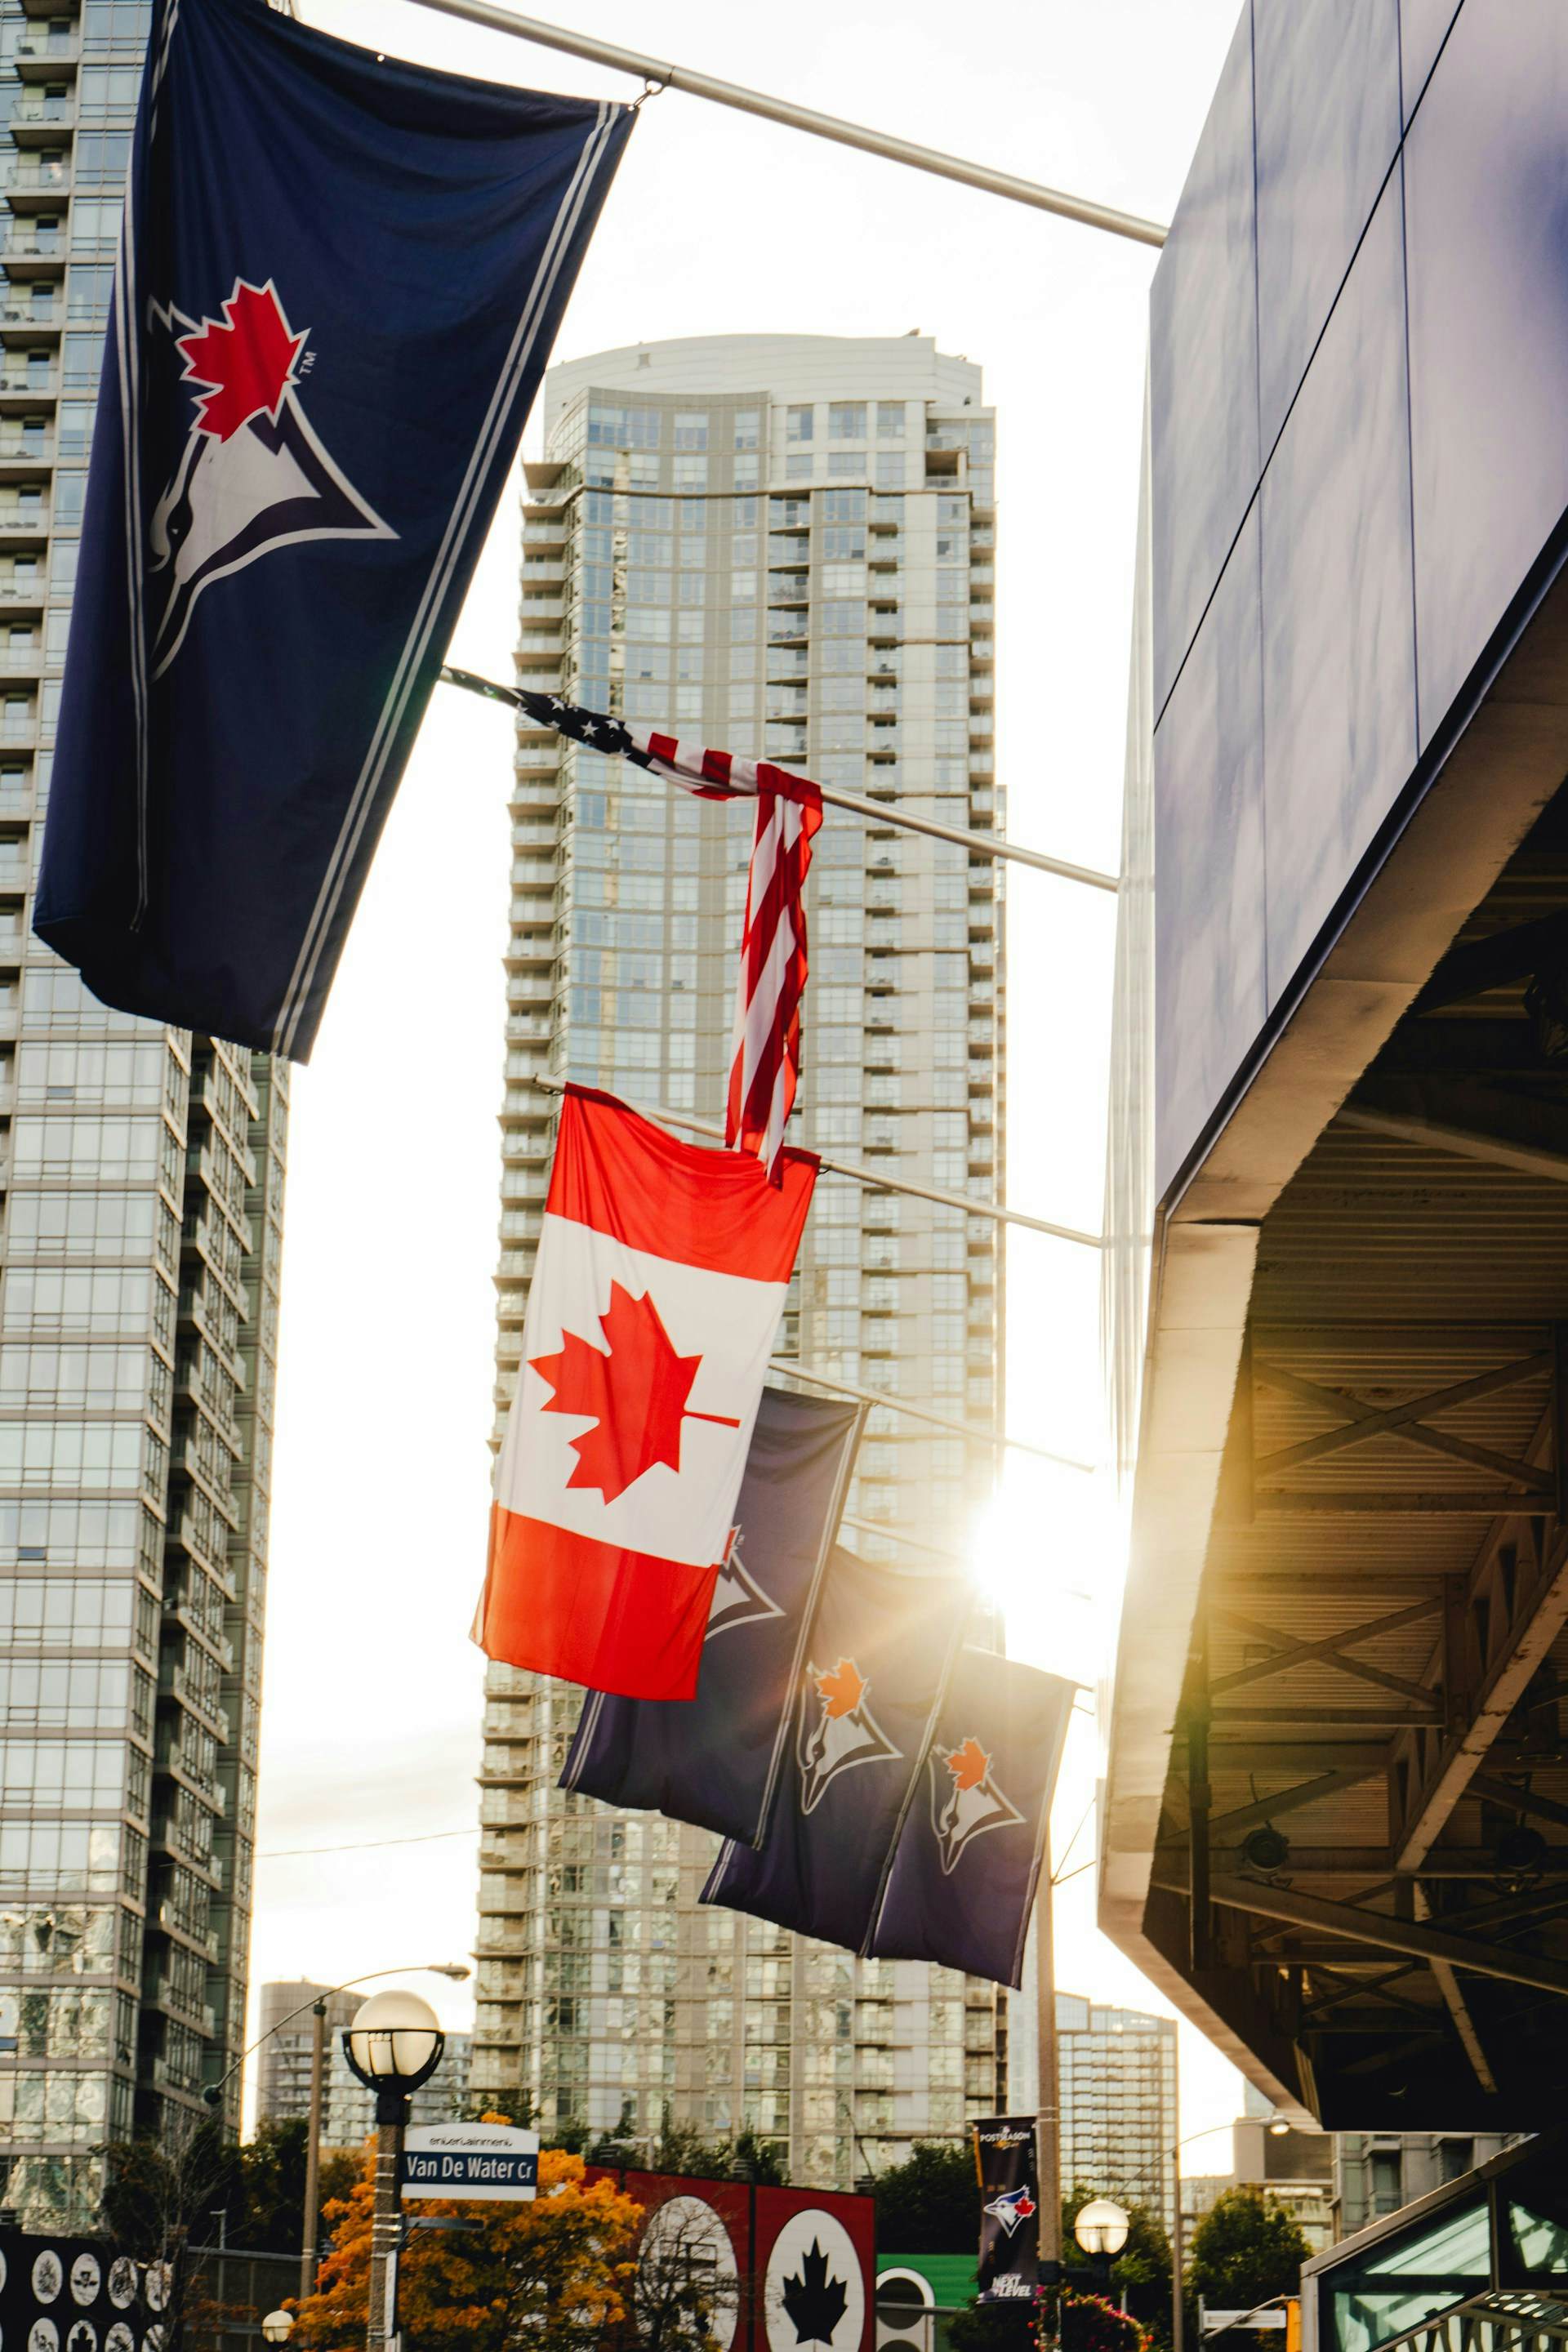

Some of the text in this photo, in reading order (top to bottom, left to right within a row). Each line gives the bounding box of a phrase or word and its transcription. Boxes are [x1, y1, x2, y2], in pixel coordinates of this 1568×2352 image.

[299, 351, 317, 374] TM
[407, 2155, 533, 2179] Van De Water Cr
[991, 2275, 1022, 2287] NEXT
[998, 2285, 1031, 2297] LEVEL
